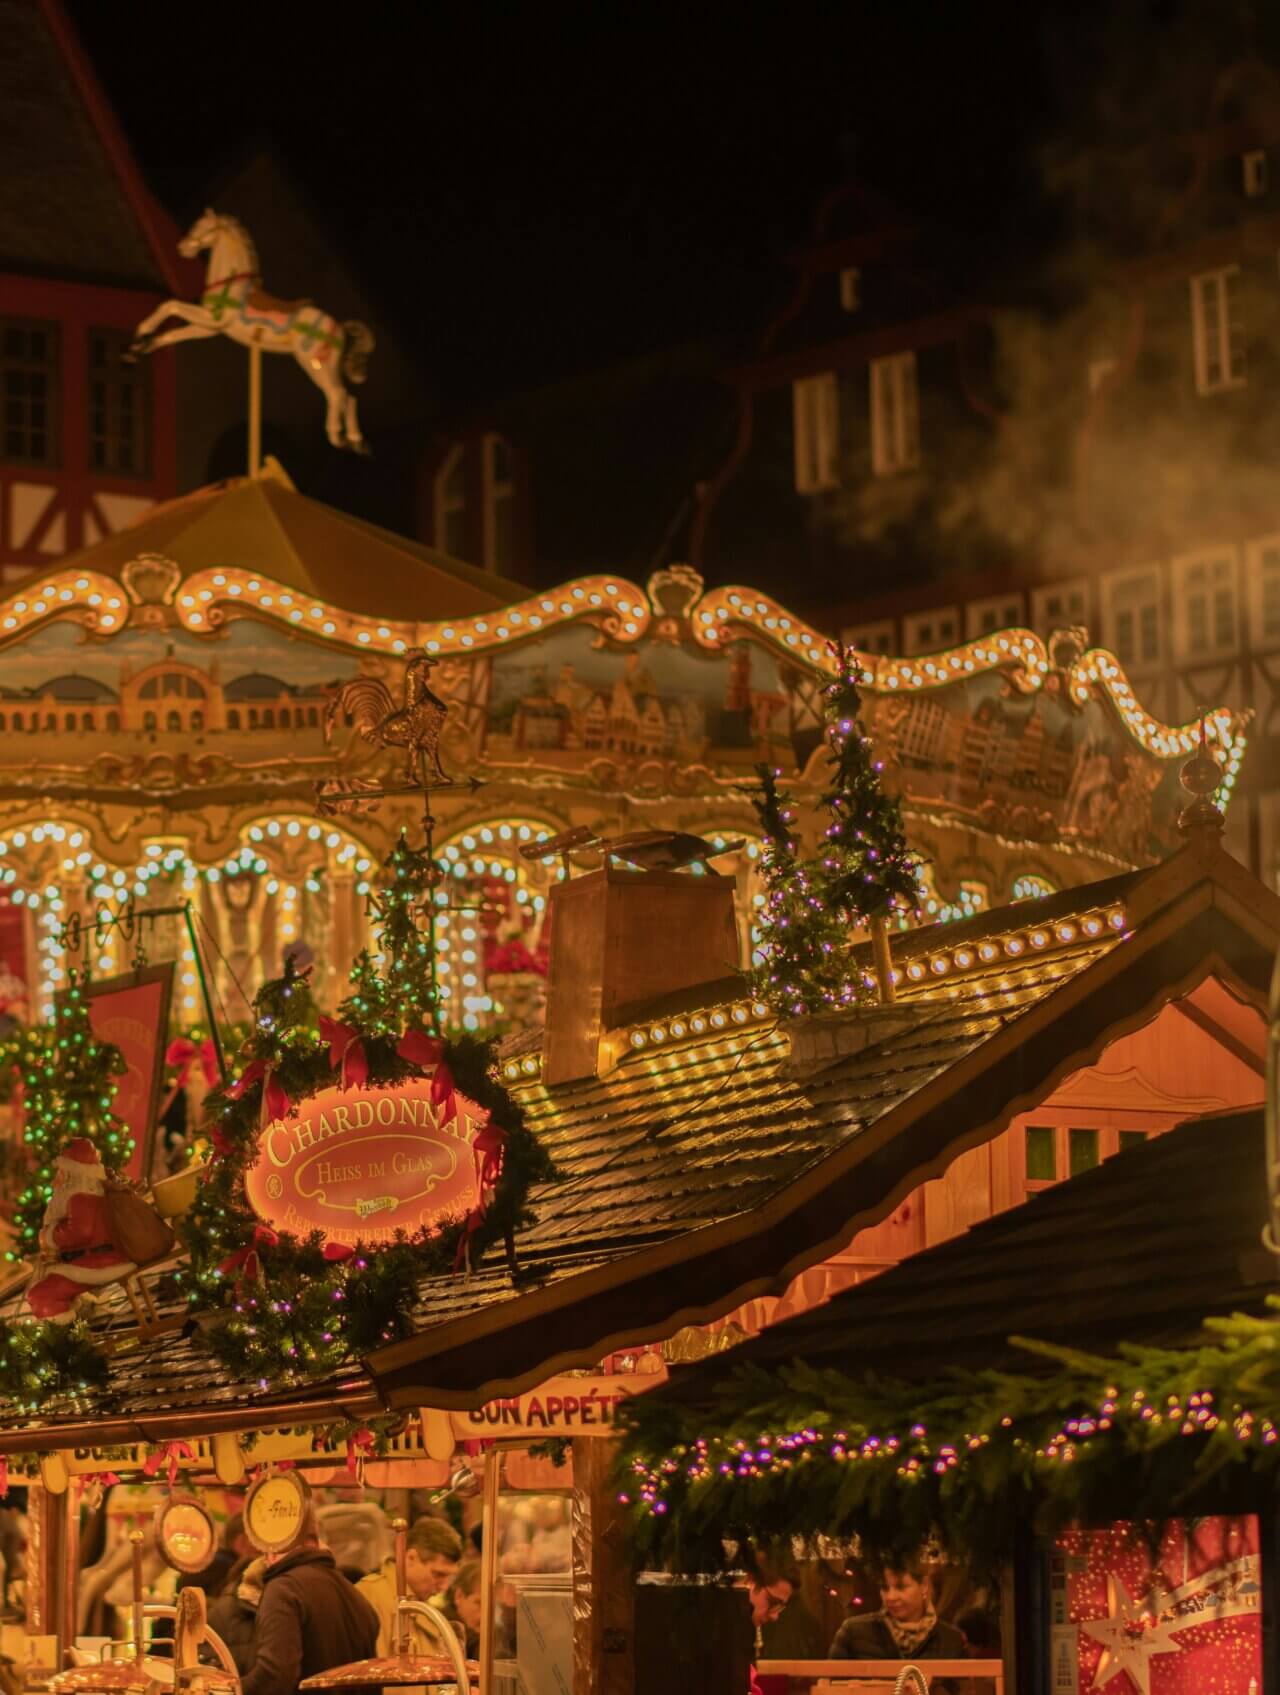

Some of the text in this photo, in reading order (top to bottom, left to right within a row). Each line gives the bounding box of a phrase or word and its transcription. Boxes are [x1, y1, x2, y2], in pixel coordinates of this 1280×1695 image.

[316, 1150, 434, 1185] HEISS IM GLAS
